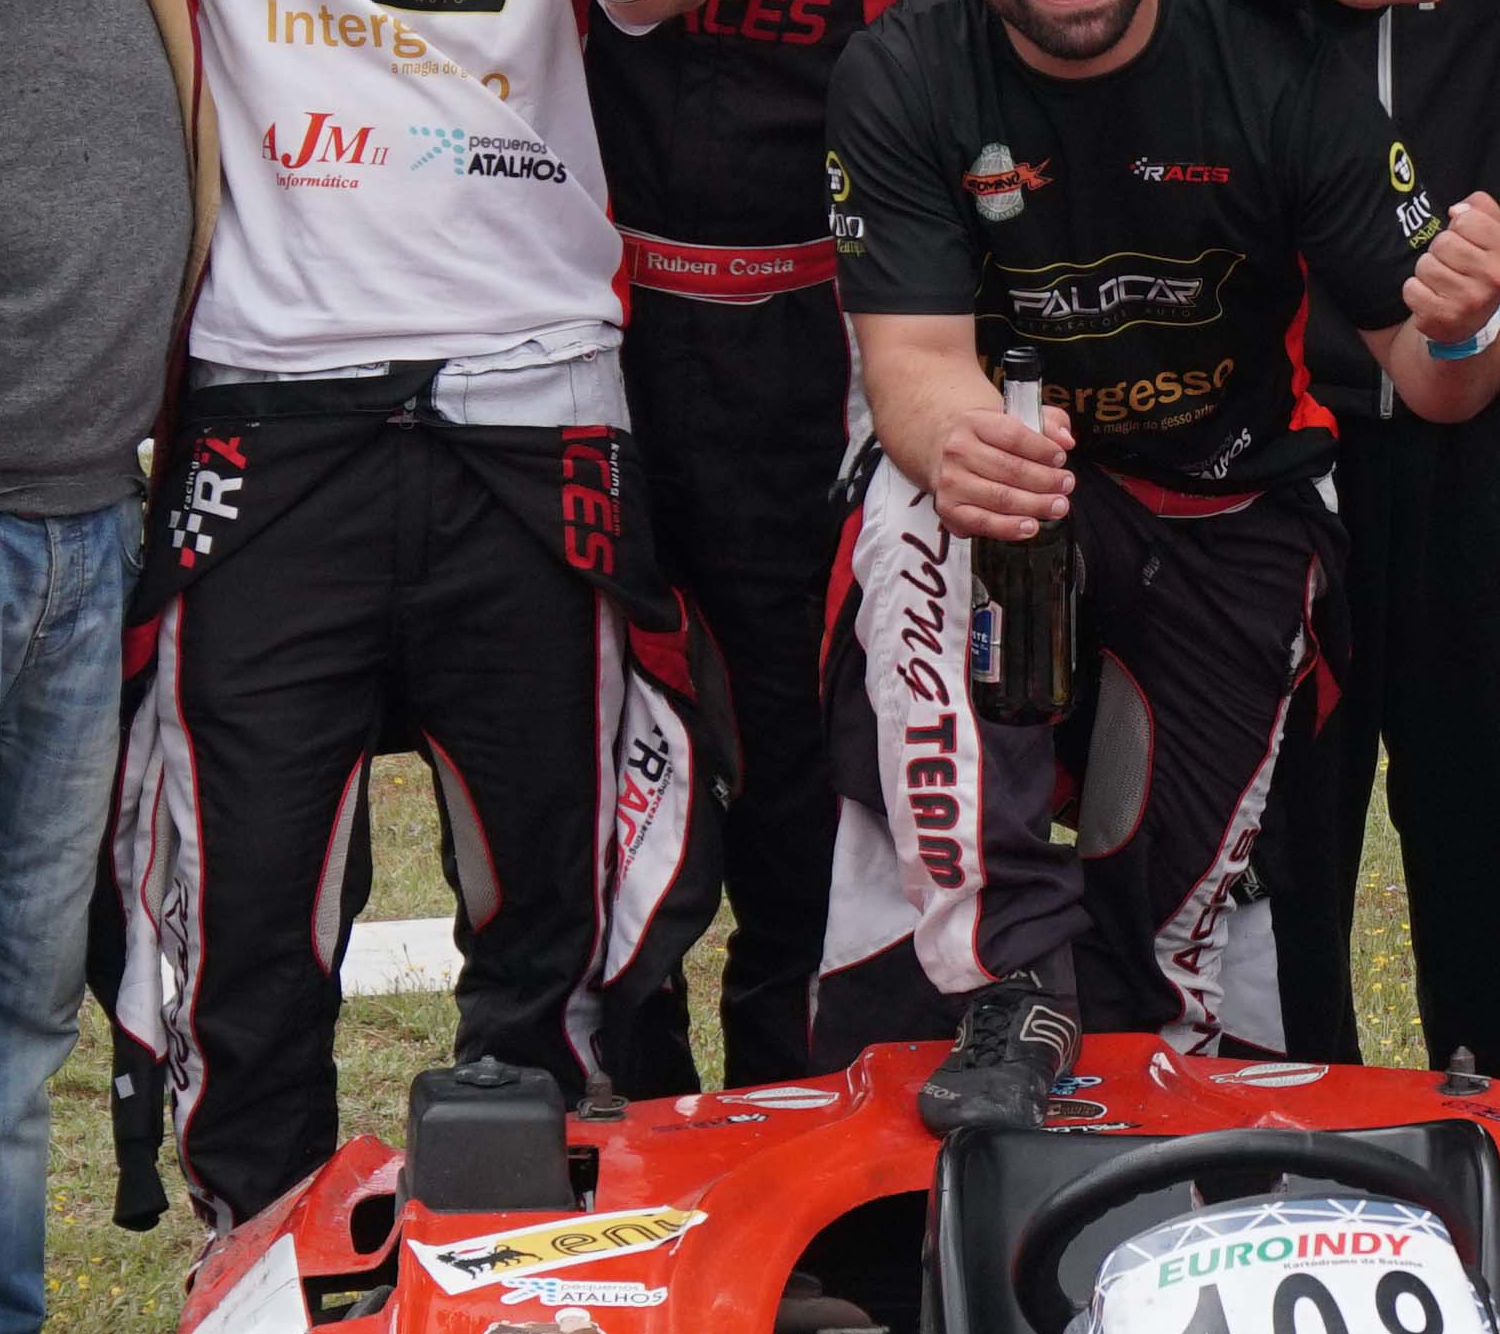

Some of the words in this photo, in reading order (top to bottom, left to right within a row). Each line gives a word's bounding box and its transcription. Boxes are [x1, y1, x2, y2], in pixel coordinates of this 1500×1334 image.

[262, 111, 376, 170] AJM
[468, 134, 548, 155] pequenos
[276, 171, 359, 190] Informática
[467, 153, 568, 184] ATALHOS
[647, 253, 718, 276] Ruben
[729, 257, 794, 276] Costa
[1008, 274, 1203, 319] PALOCAR
[905, 711, 966, 889] TEAM
[550, 1212, 683, 1257] eni
[1158, 1231, 1412, 1289] EUROINDY
[560, 1288, 664, 1305] ATALHOS
